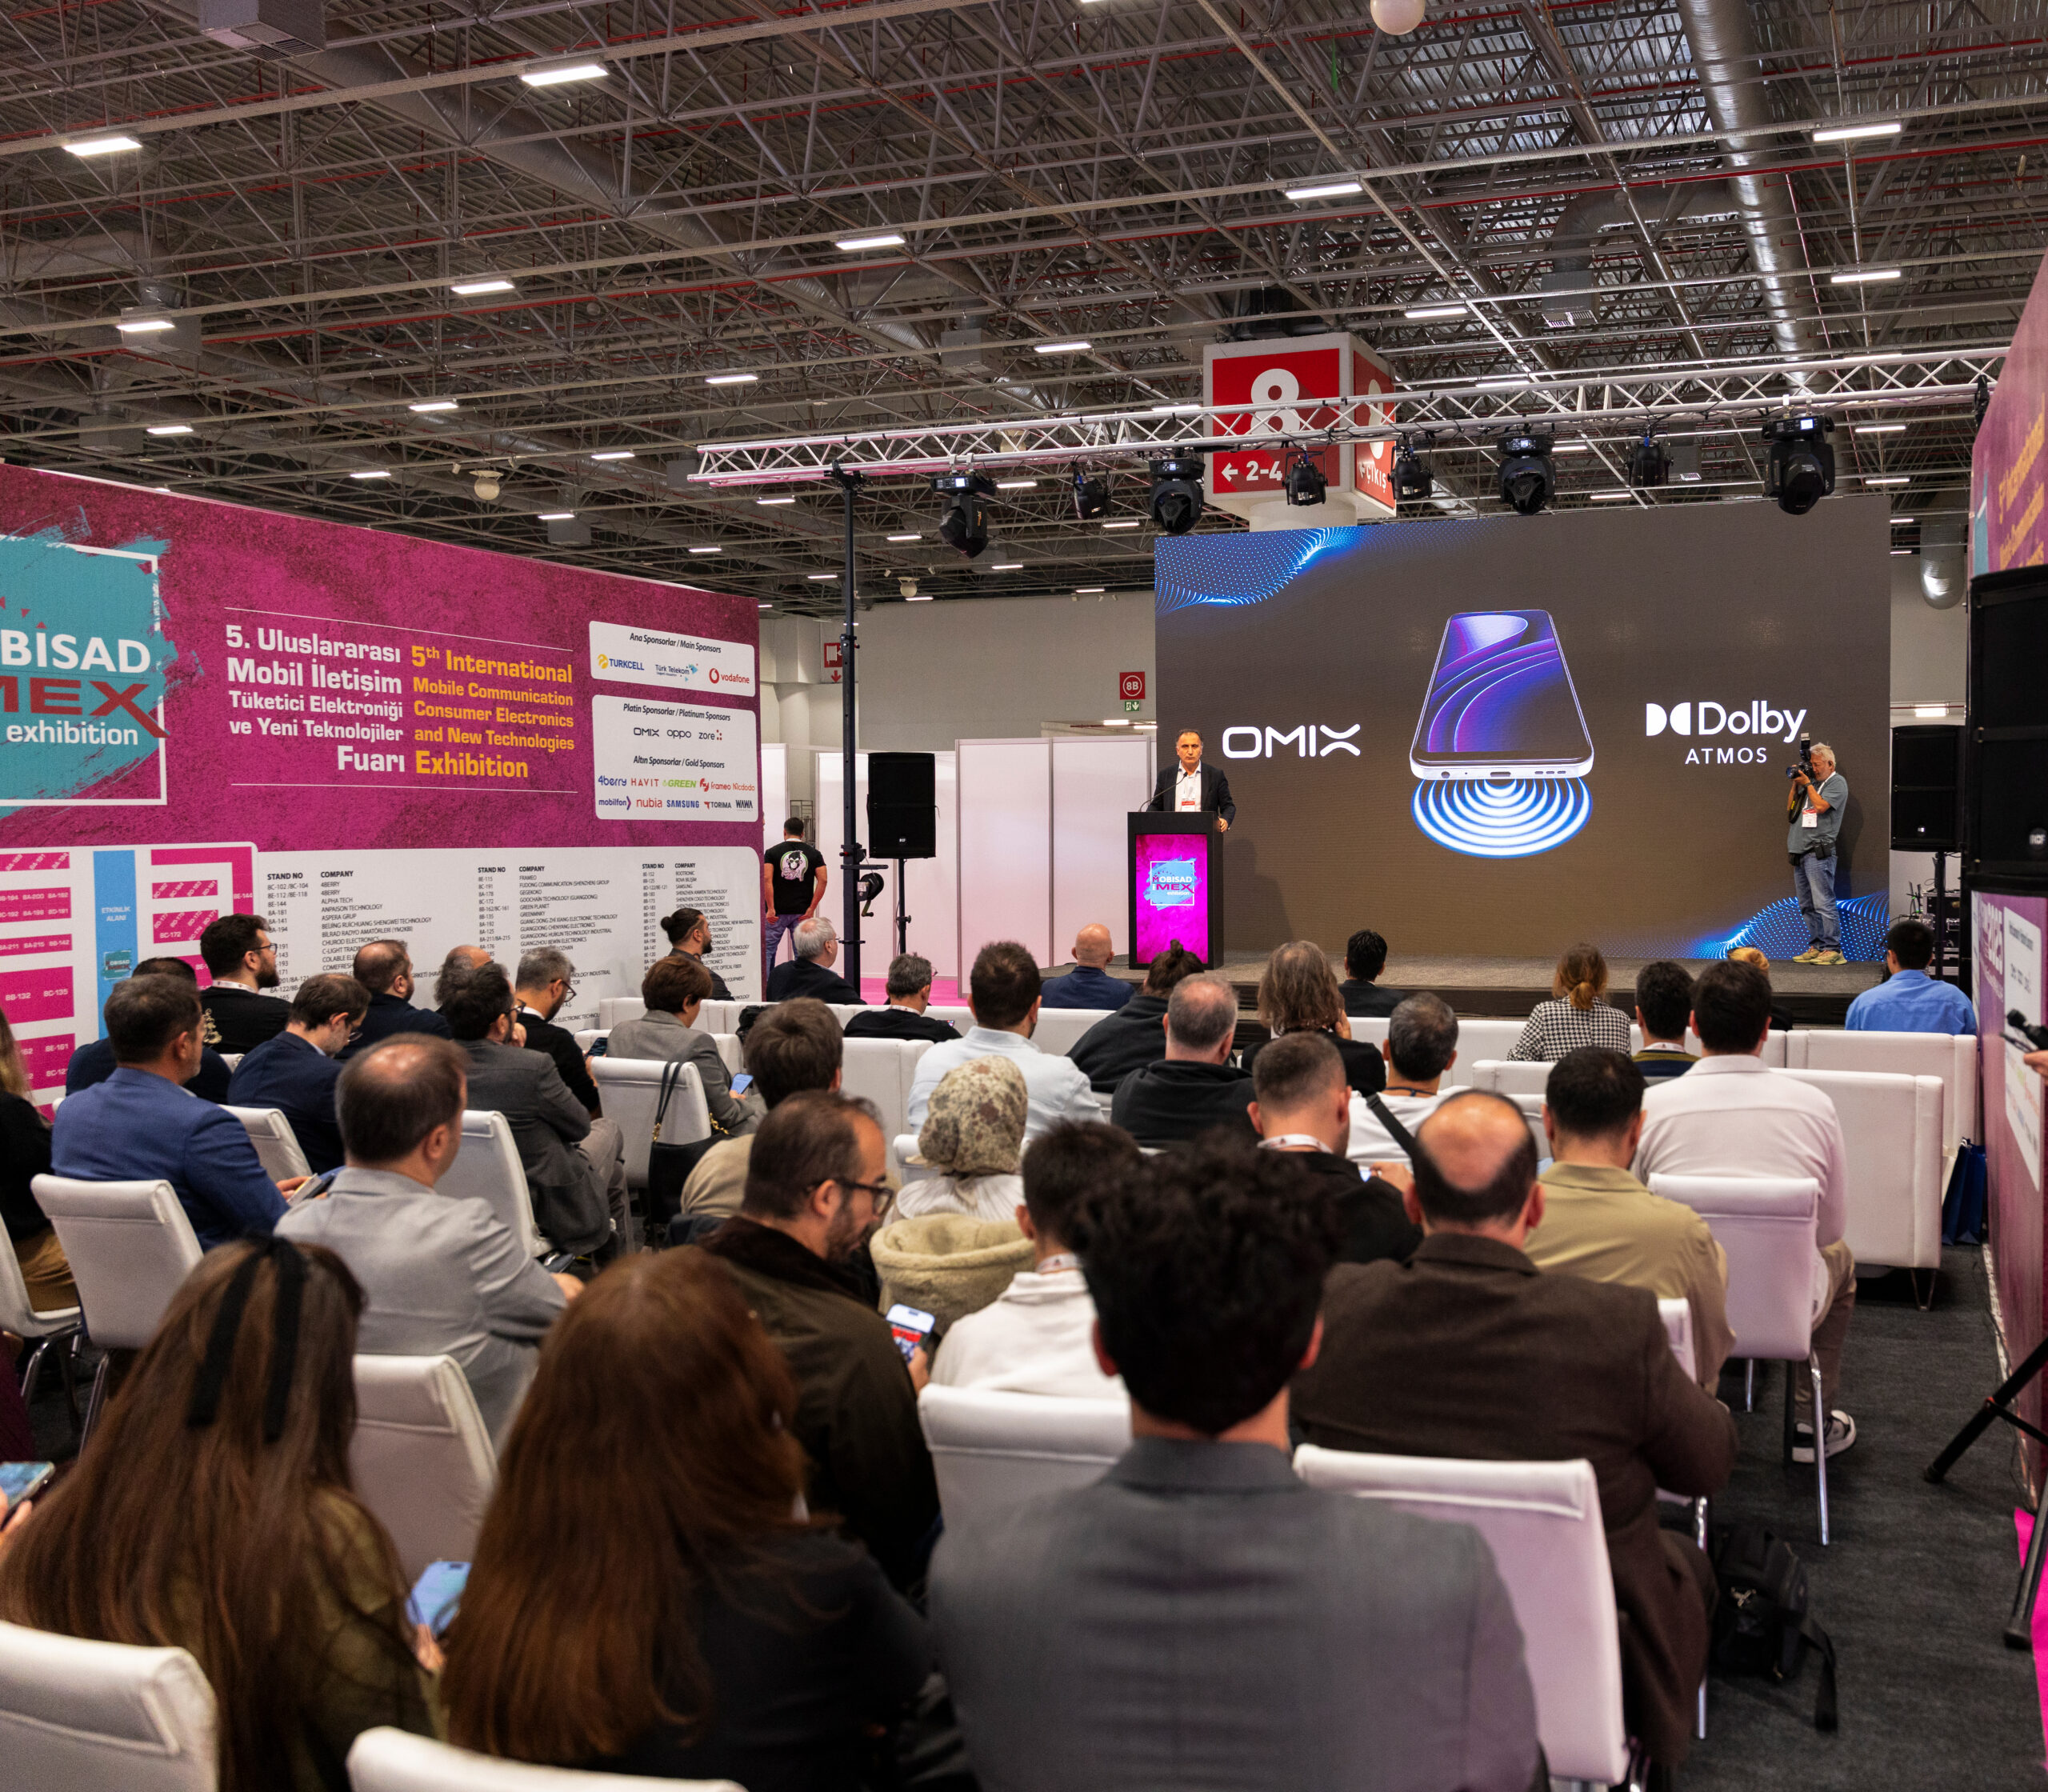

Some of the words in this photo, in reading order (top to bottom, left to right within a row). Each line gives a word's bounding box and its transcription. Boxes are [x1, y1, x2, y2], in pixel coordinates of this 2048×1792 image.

[1246, 461, 1282, 482] 2-4
[1366, 466, 1386, 493] ÇIKIŞ
[226, 625, 250, 650] 5.
[257, 627, 401, 663] Uluslararası
[630, 632, 643, 642] Ana
[643, 634, 677, 647] Sponsorlar
[680, 640, 695, 650] Main
[695, 642, 722, 654] Sponsors
[411, 645, 440, 668] 5th
[446, 650, 574, 684] International
[609, 658, 645, 671] TURKCELL
[655, 664, 667, 672] Türk
[668, 666, 690, 675] Telekom
[721, 674, 750, 684] vodafone
[227, 658, 304, 687] Mobil
[310, 658, 402, 698] İletişim
[1126, 682, 1138, 690] 8B
[413, 677, 465, 697] Mobile
[468, 682, 574, 706] Communication
[229, 690, 305, 712] Tüketici
[310, 694, 403, 722] Elektroniği
[414, 701, 492, 722] Consumer
[495, 706, 574, 728] Electronics
[623, 703, 642, 713] Platin
[642, 705, 675, 717] Sponsorlar
[679, 710, 705, 719] Platinum
[706, 712, 731, 722] Sponsors
[6, 719, 138, 746] exhibition
[229, 720, 253, 735] ve
[257, 718, 298, 737] Yeni
[302, 720, 404, 743] Teknolojiler
[634, 727, 660, 738] OMIX
[666, 729, 692, 740] oppo
[698, 731, 715, 740] zore
[1698, 700, 1807, 743] Dolby
[414, 728, 444, 743] and
[448, 726, 482, 746] New
[485, 730, 575, 753] Technologies
[1222, 724, 1361, 758] OMIX
[338, 746, 406, 772] Fuarı
[416, 750, 529, 778] Exhibition
[634, 755, 649, 764] Altın
[649, 756, 682, 767] Sponsorlar
[685, 758, 699, 767] Gold
[699, 760, 725, 770] Sponsors
[1685, 747, 1767, 765] ATMOS
[598, 775, 627, 786] 4berry
[630, 778, 659, 787] HAVIT
[667, 780, 697, 788] GREEN
[598, 798, 627, 806] mobilfon
[636, 798, 663, 808] nubia
[666, 799, 700, 808] SAMSUNG
[735, 799, 754, 809] WAWA
[267, 873, 291, 881] STAND
[320, 870, 354, 878] COMPANY
